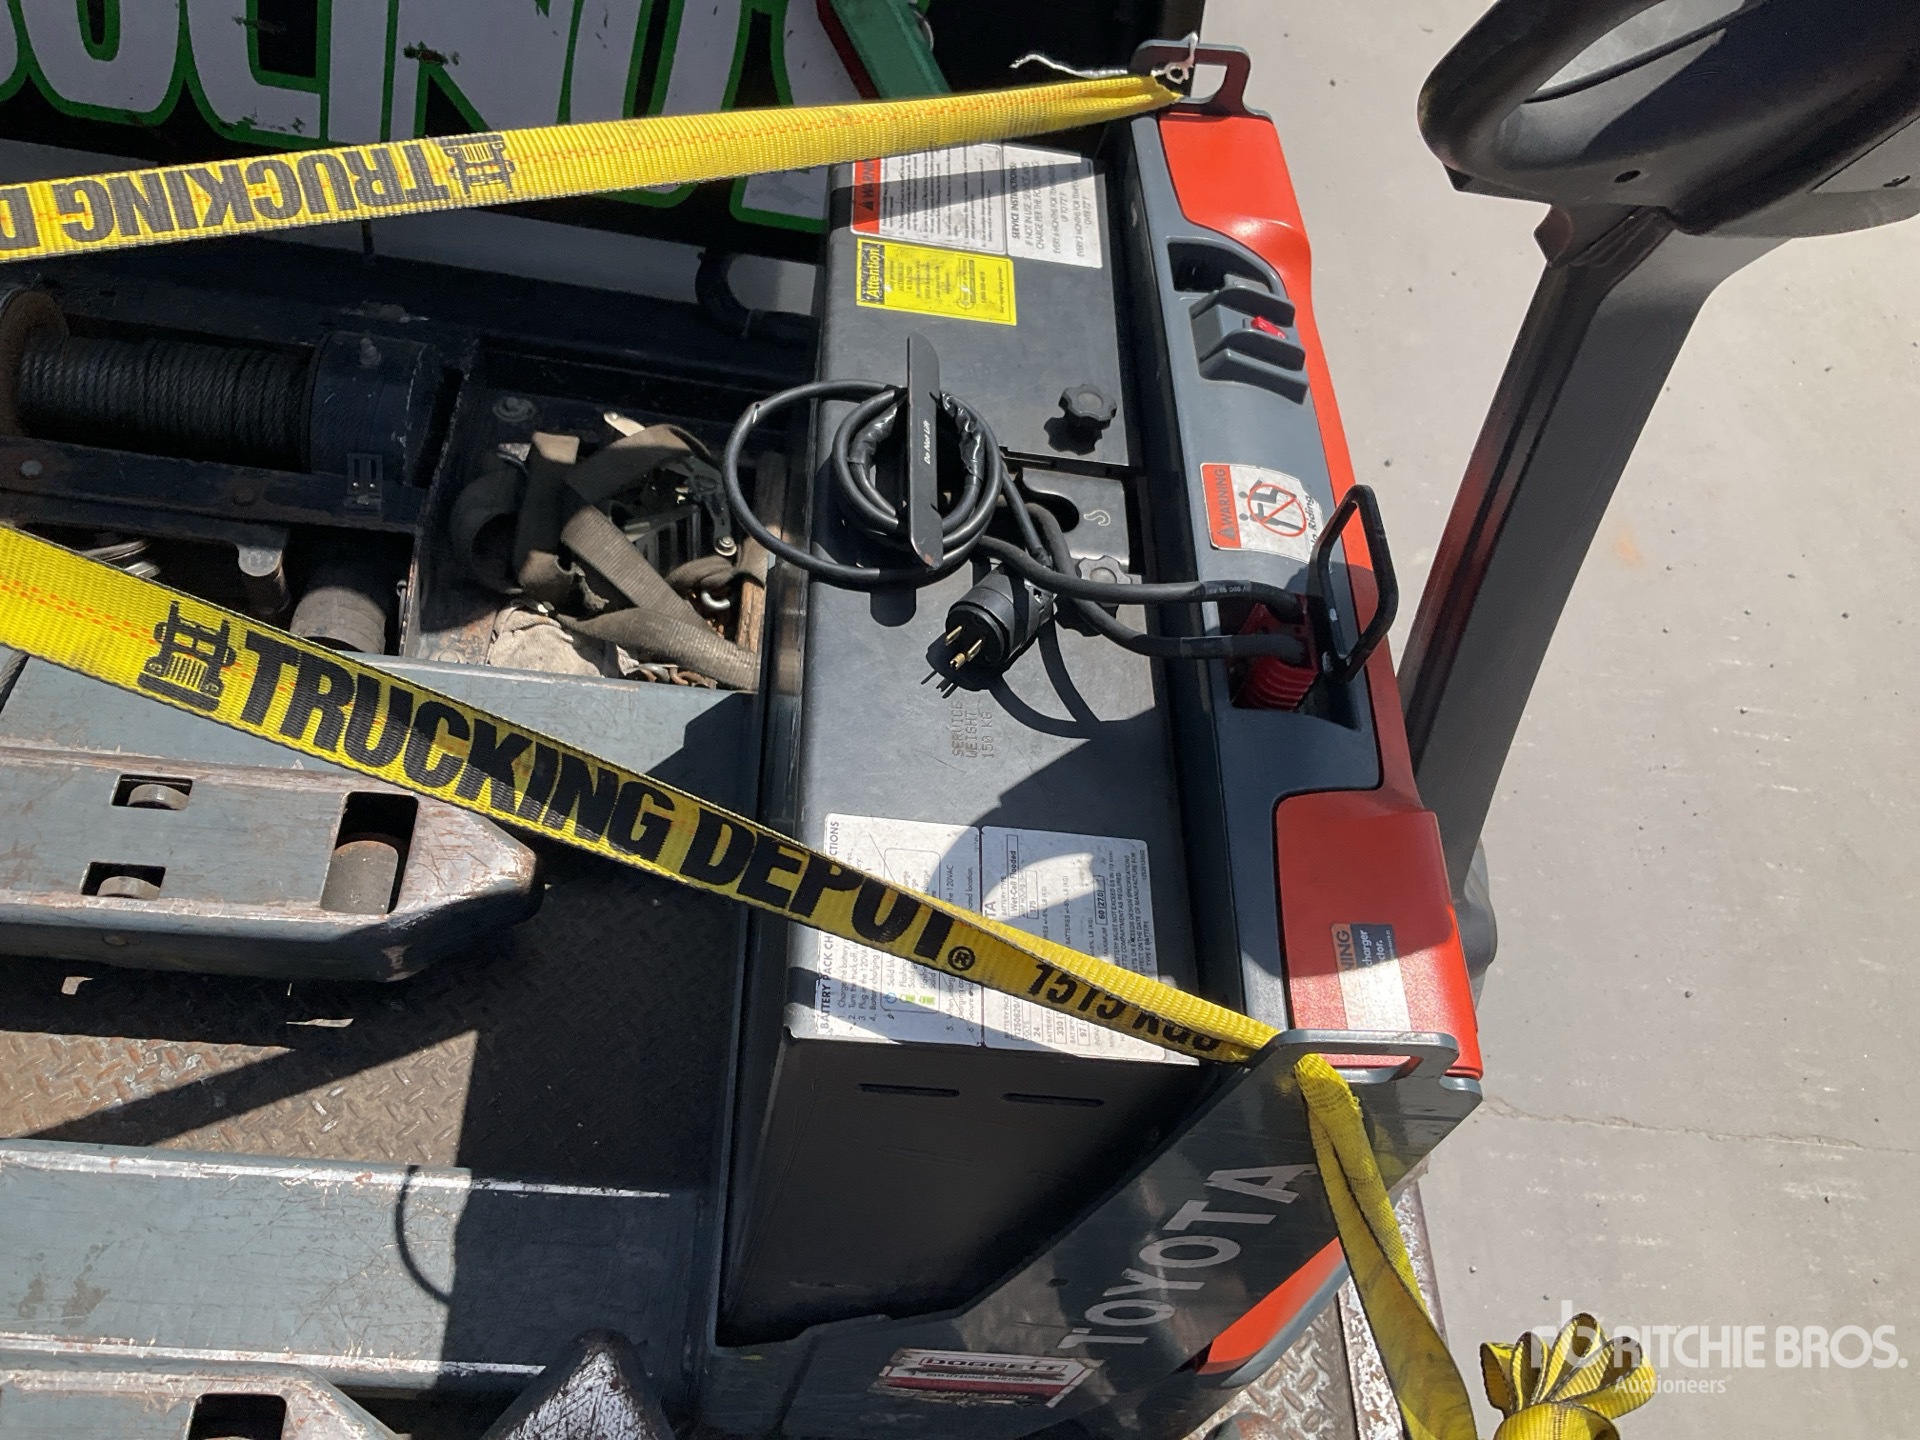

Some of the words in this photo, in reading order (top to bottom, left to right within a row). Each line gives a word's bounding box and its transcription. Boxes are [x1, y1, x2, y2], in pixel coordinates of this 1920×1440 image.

[52, 145, 452, 242] TRUCKING
[1011, 213, 1020, 239] SERVICE
[1035, 211, 1043, 222] PER
[1060, 214, 1068, 222] UP
[1083, 210, 1092, 225] OVER
[1025, 224, 1033, 240] NOT
[1035, 223, 1044, 249] CHARGE
[866, 248, 881, 298] Attention
[924, 452, 930, 465] Do
[1214, 467, 1232, 526] WARNING
[1304, 495, 1317, 530] Riding
[951, 700, 964, 757] SERVICE
[981, 711, 993, 727] KG
[240, 630, 676, 862] TRUCKING
[965, 711, 977, 758] WEIGHT
[981, 735, 994, 759] 150
[829, 821, 839, 856] CTIONS
[1009, 851, 1017, 879] Flooded
[946, 865, 954, 891] 120VAC
[1132, 864, 1140, 906] MANUFACTURE
[1009, 882, 1018, 911] Wet-Cell
[1097, 890, 1105, 908] (27.0)
[1118, 901, 1124, 909] AS
[1097, 910, 1105, 919] 60
[1136, 906, 1141, 914] OF
[840, 945, 849, 968] battery
[1138, 943, 1143, 951] ON
[1360, 930, 1373, 966] charger
[821, 953, 833, 981] PACK
[861, 948, 869, 971] 120VA
[887, 970, 895, 986] Solid
[908, 972, 916, 988] Solid
[947, 976, 955, 996] charg
[820, 984, 831, 1029] BATTERY
[838, 983, 847, 1008] Charge
[849, 993, 857, 1008] Turn
[859, 995, 868, 1009] Plug
[870, 987, 878, 1010] Battery
[966, 998, 974, 1020] Secure
[1034, 1027, 1041, 1037] 24
[1056, 1021, 1064, 1036] 330
[1080, 1028, 1087, 1038] 97
[1057, 1164, 1318, 1349] TOYOTA
